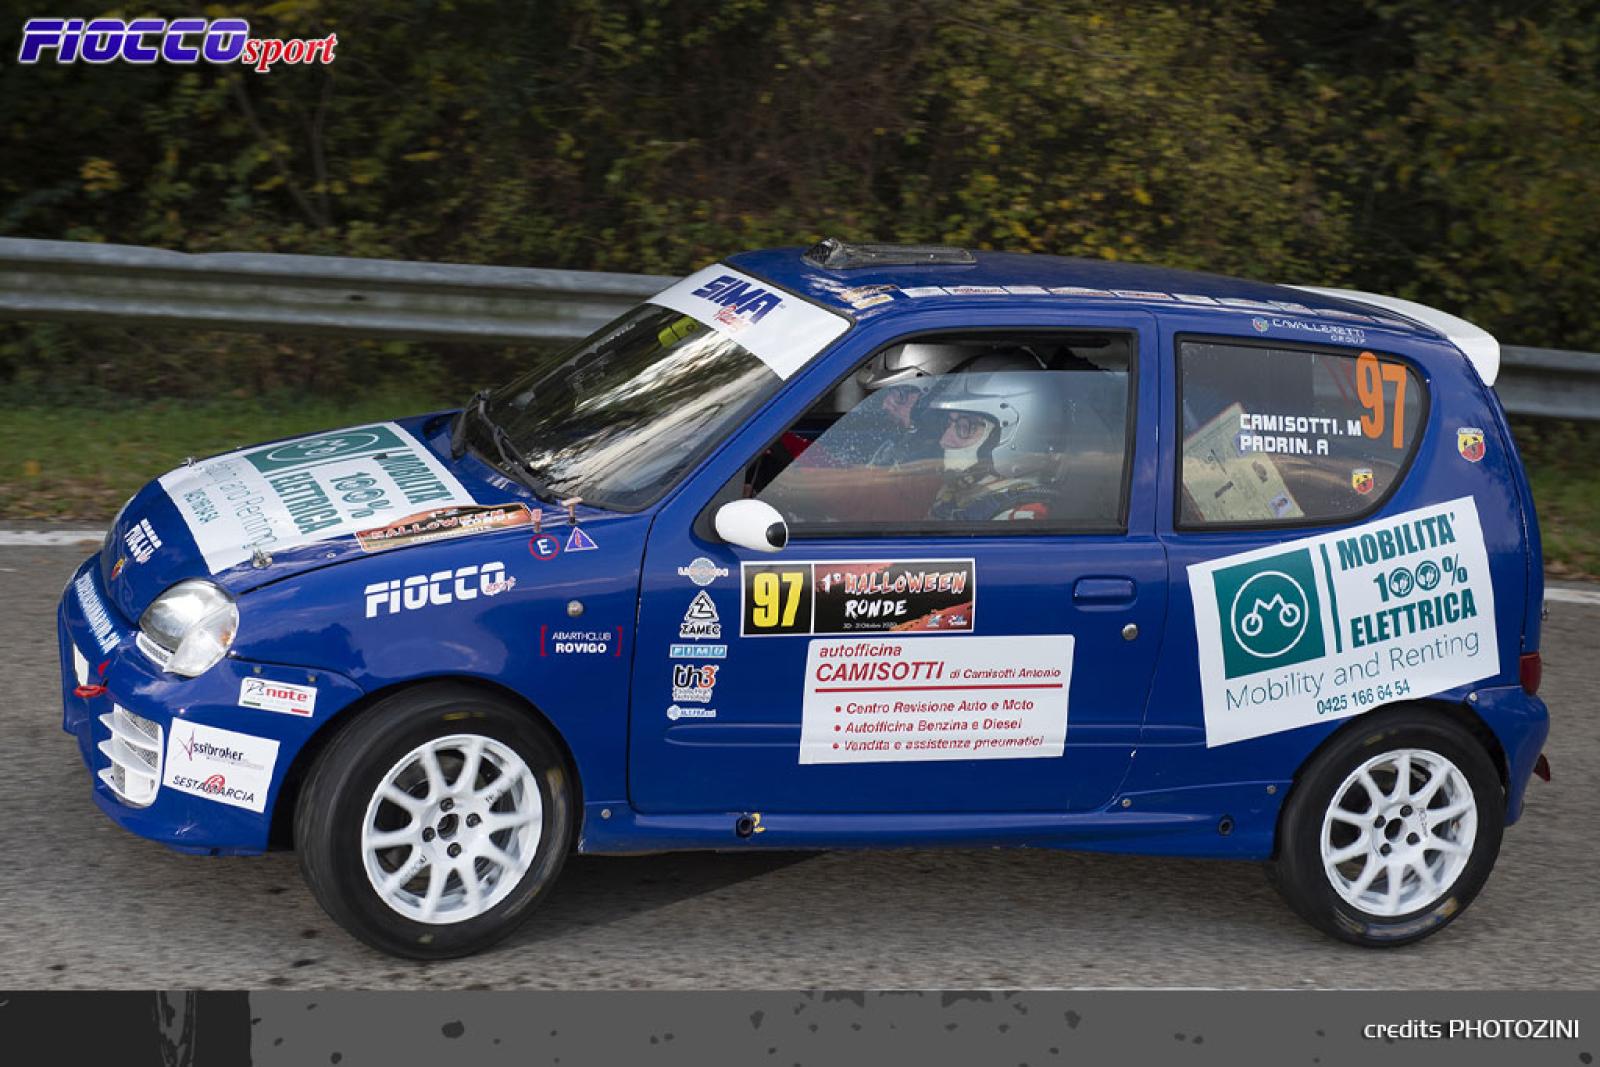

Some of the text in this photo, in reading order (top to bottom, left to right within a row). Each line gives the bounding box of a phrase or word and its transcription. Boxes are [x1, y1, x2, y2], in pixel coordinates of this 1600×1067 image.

[691, 274, 784, 325] SIMA
[1356, 351, 1407, 449] 97
[1347, 422, 1362, 437] M
[1317, 438, 1329, 455] A
[270, 471, 344, 535] ELETTRICA
[537, 538, 552, 555] E
[845, 571, 968, 594] HALLOWEEN
[1373, 553, 1468, 602] 100%
[364, 561, 507, 619] FIOCCO
[752, 572, 803, 627] 97
[845, 600, 907, 618] RONDE
[1350, 588, 1478, 648] ELETTRICA
[680, 624, 720, 635] ZAMEC
[555, 643, 607, 654] ROVIGO
[819, 643, 902, 658] autofficina
[816, 661, 1061, 682] CAMISOTTI di Camisotti Antonio
[1225, 630, 1480, 712] Mobility and Renting
[266, 688, 308, 702] note
[1317, 679, 1410, 715] 0425 166 64 54
[846, 699, 1034, 714] Centro Revisione Auto e Moto
[845, 718, 1022, 733] Autofficina Benzina e Diesel
[844, 735, 1044, 751] Vendita e assistenza pneumatici
